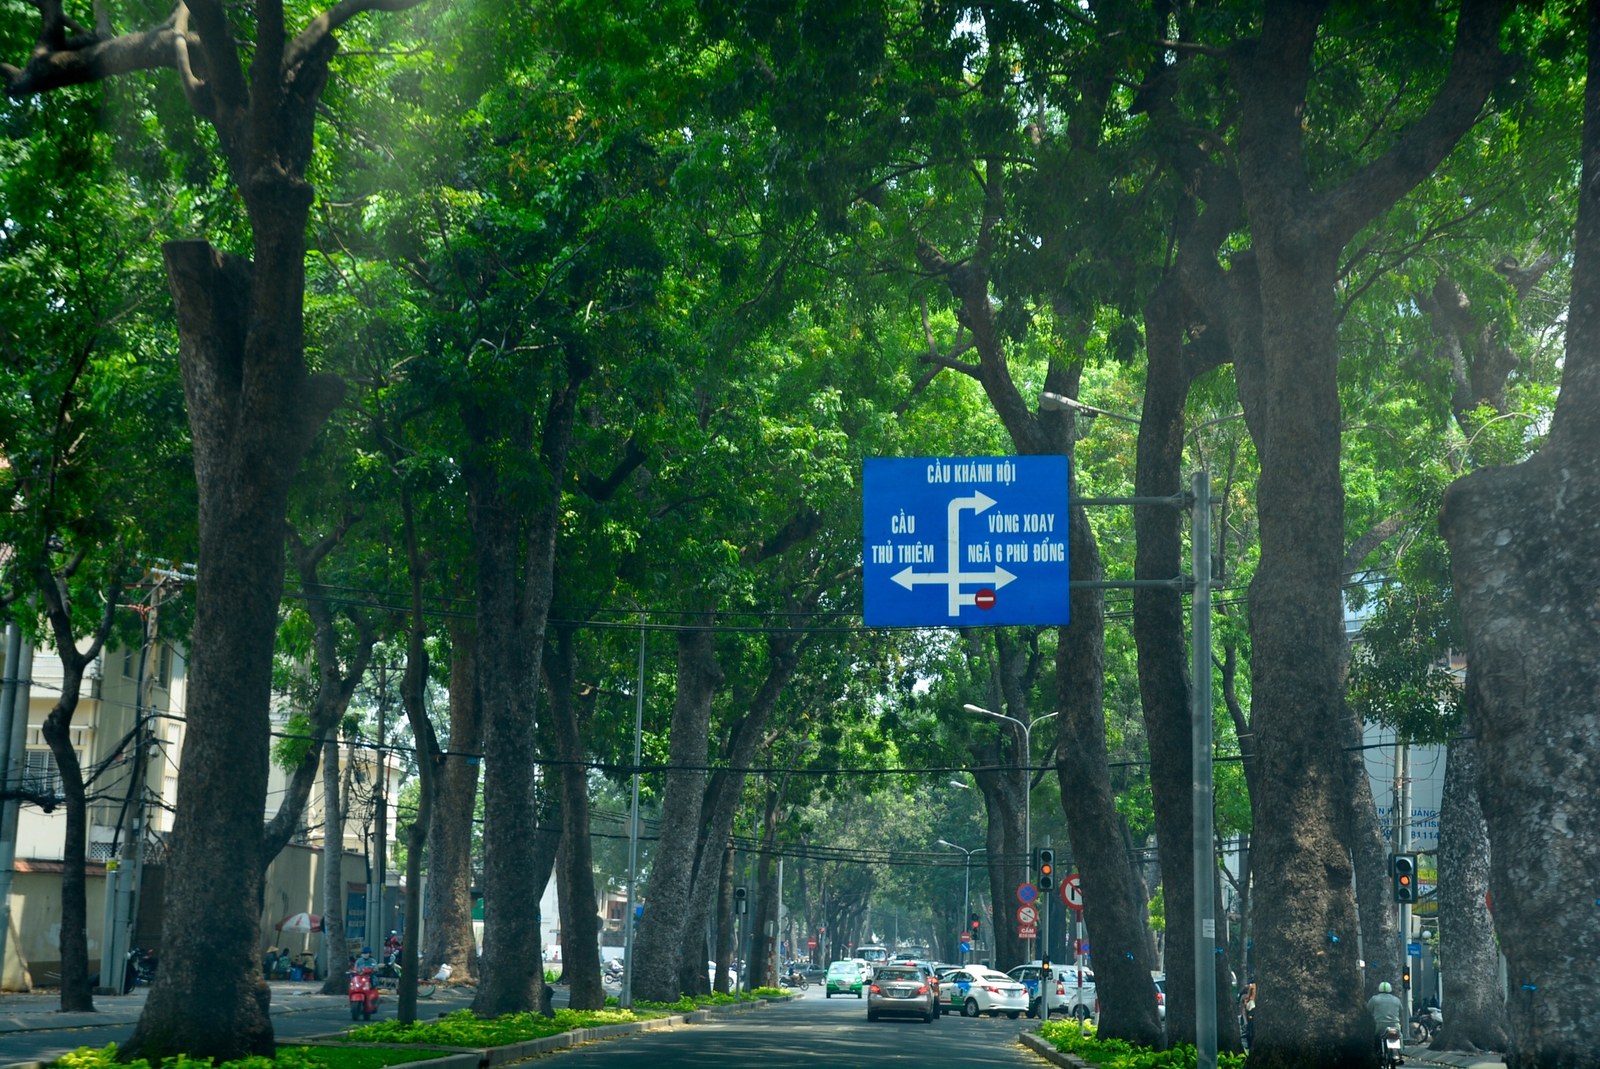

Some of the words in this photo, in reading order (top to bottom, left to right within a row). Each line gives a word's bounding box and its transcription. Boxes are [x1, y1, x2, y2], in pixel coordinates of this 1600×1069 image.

[927, 458, 951, 483] CẦU
[954, 461, 993, 483] KHÁNH
[996, 460, 1016, 486] HỘI
[891, 508, 915, 534] CẦU
[988, 510, 1019, 533] VÒNG
[1023, 513, 1055, 533] XOAY
[871, 540, 893, 564] THỦ
[897, 541, 934, 563] THIÊM
[967, 541, 991, 563] NGÃ
[995, 543, 1003, 563] 6
[1006, 540, 1028, 563] PHÙ
[1033, 536, 1065, 562] ĐỔNG
